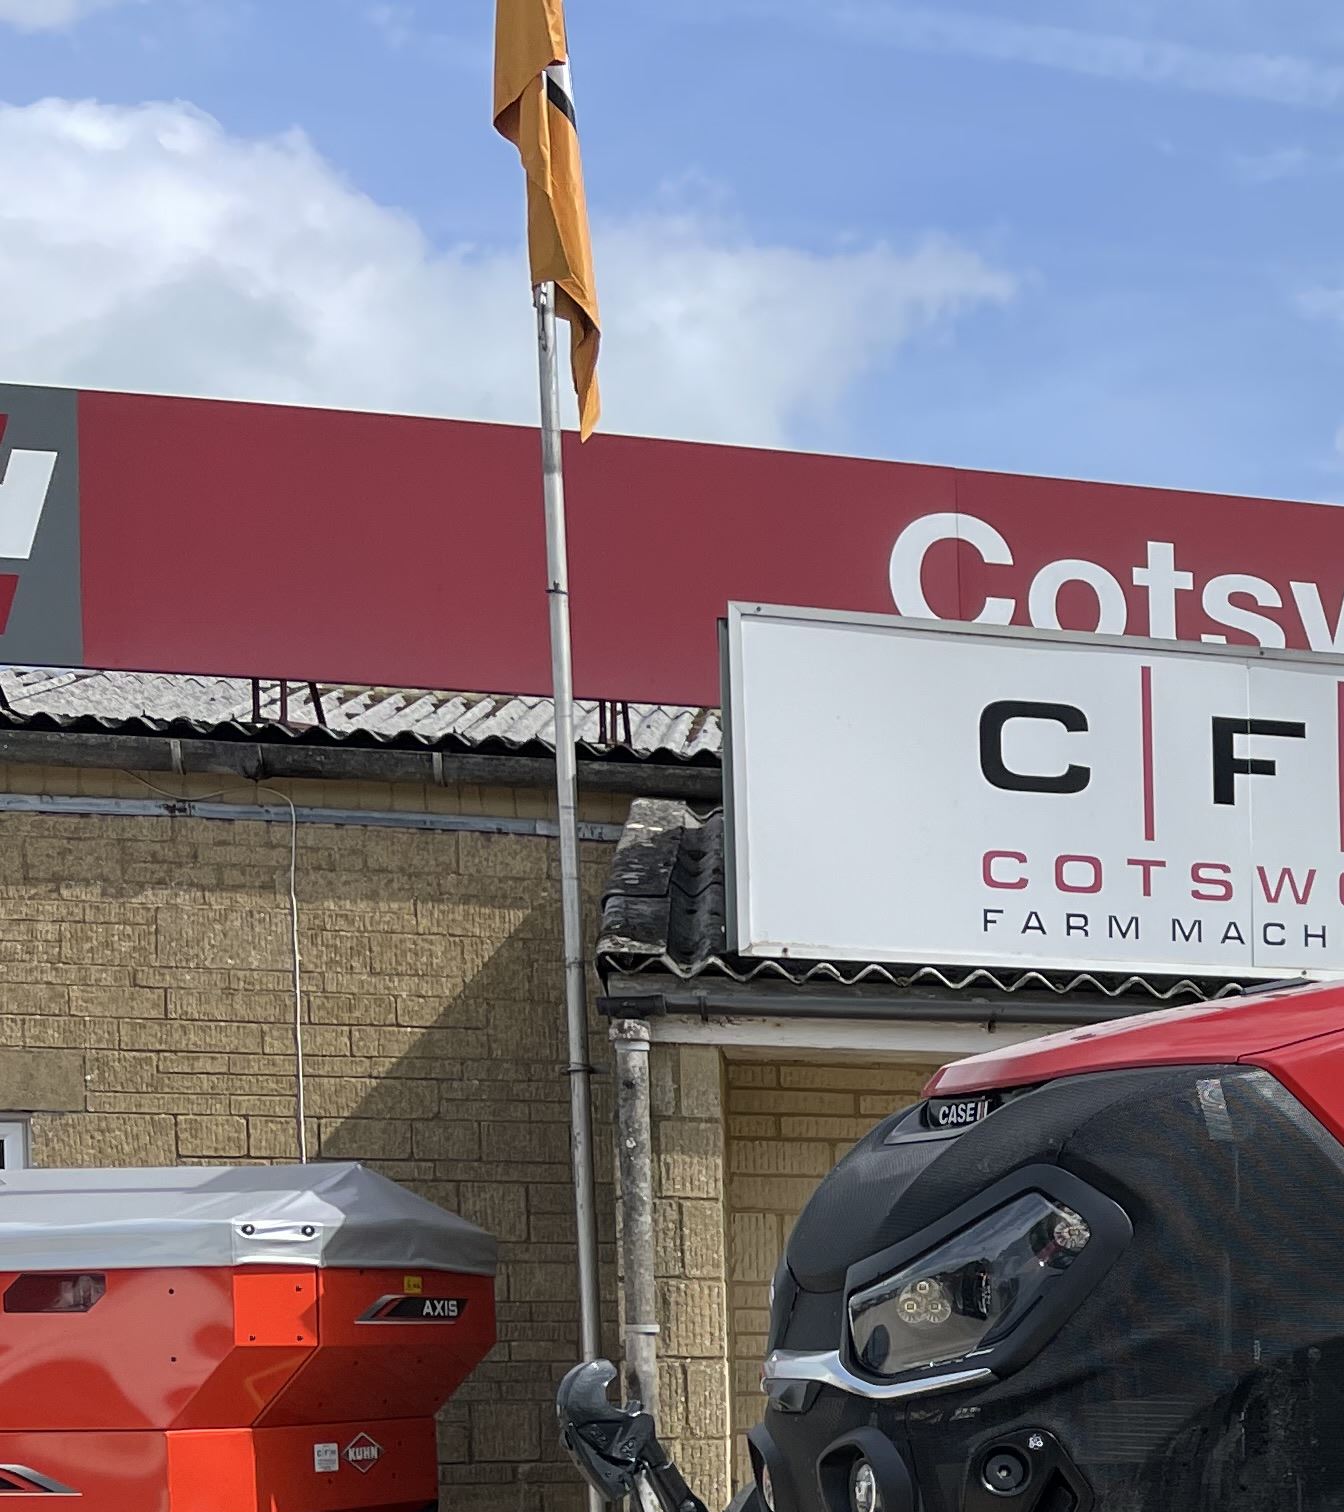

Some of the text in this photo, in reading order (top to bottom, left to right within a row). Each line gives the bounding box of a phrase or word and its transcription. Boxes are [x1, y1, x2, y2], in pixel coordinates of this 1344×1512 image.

[983, 908, 1140, 940] FARM
[938, 1102, 976, 1125] CASE
[422, 1300, 458, 1316] AXIS
[348, 1446, 378, 1461] KUHN
